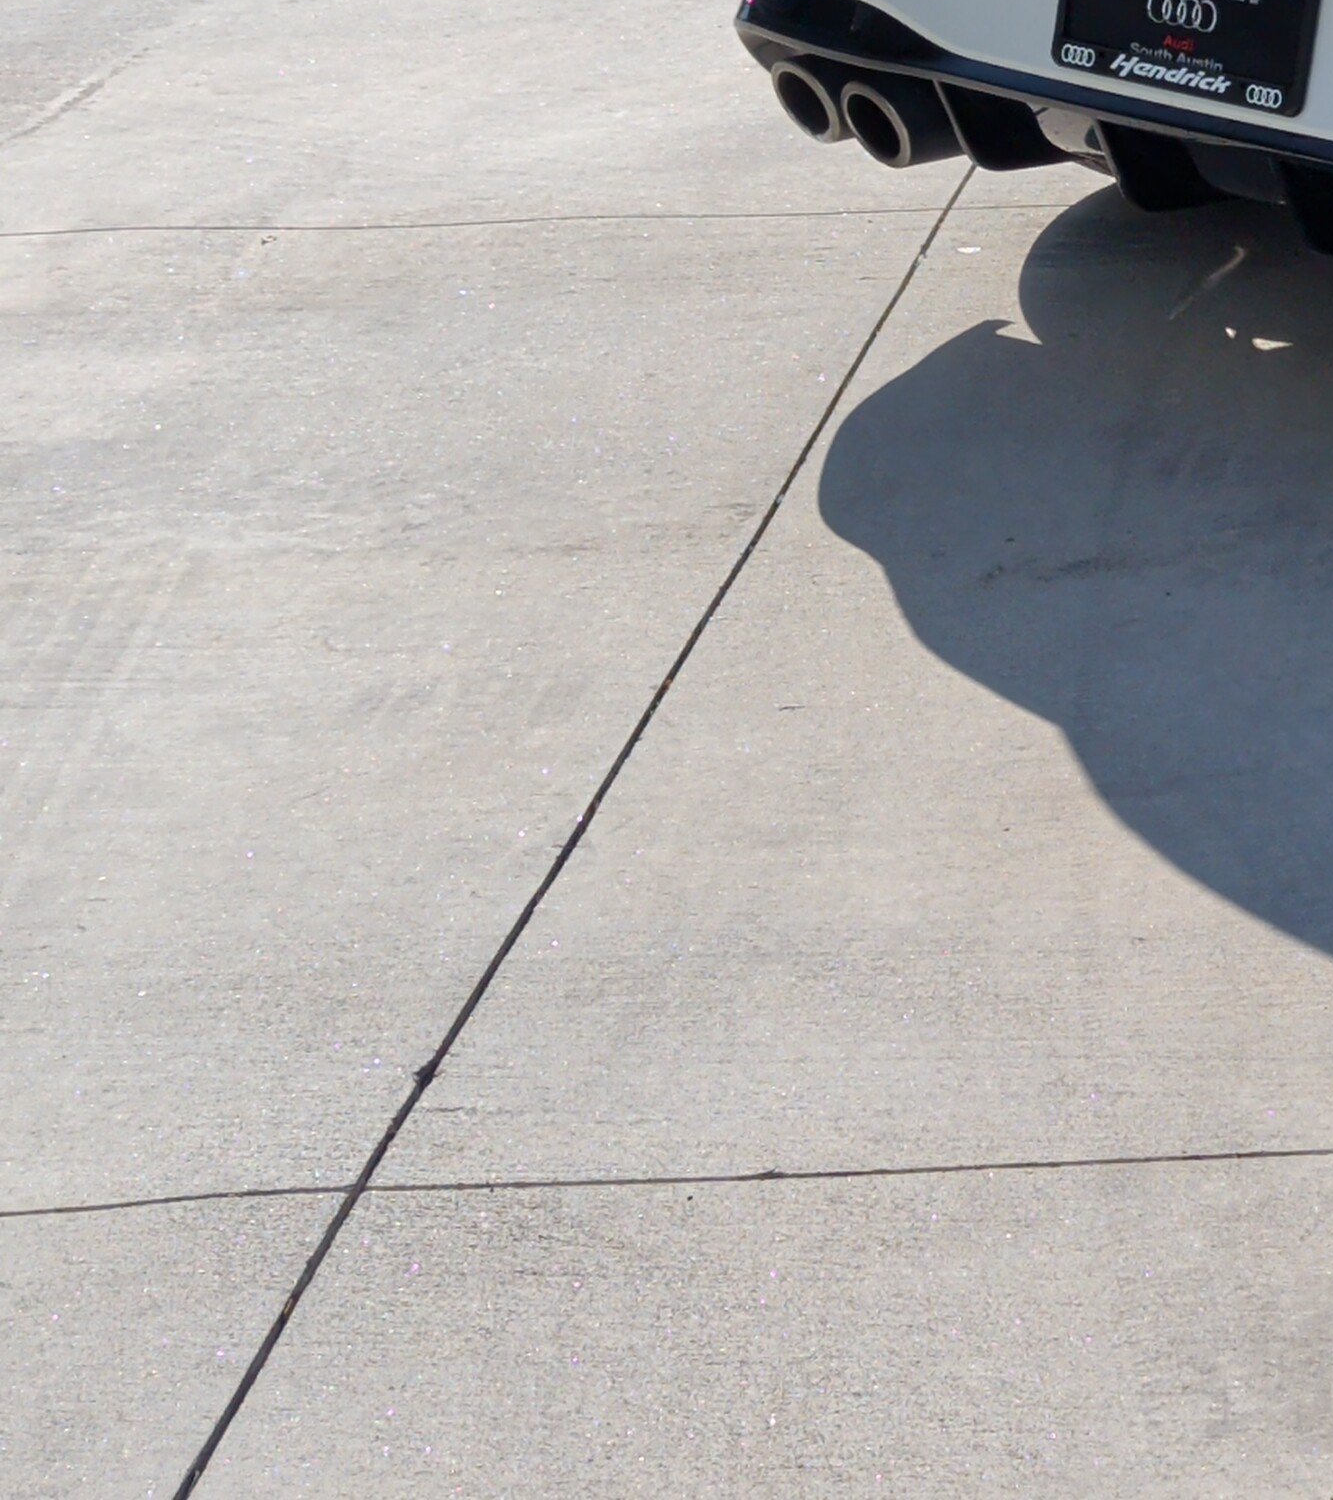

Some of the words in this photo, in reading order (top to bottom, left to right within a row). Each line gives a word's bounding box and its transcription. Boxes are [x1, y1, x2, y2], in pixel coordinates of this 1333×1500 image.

[1130, 41, 1173, 61] South
[1176, 52, 1223, 72] Austin
[1163, 34, 1195, 51] Audi
[1109, 53, 1232, 94] Hendrick
